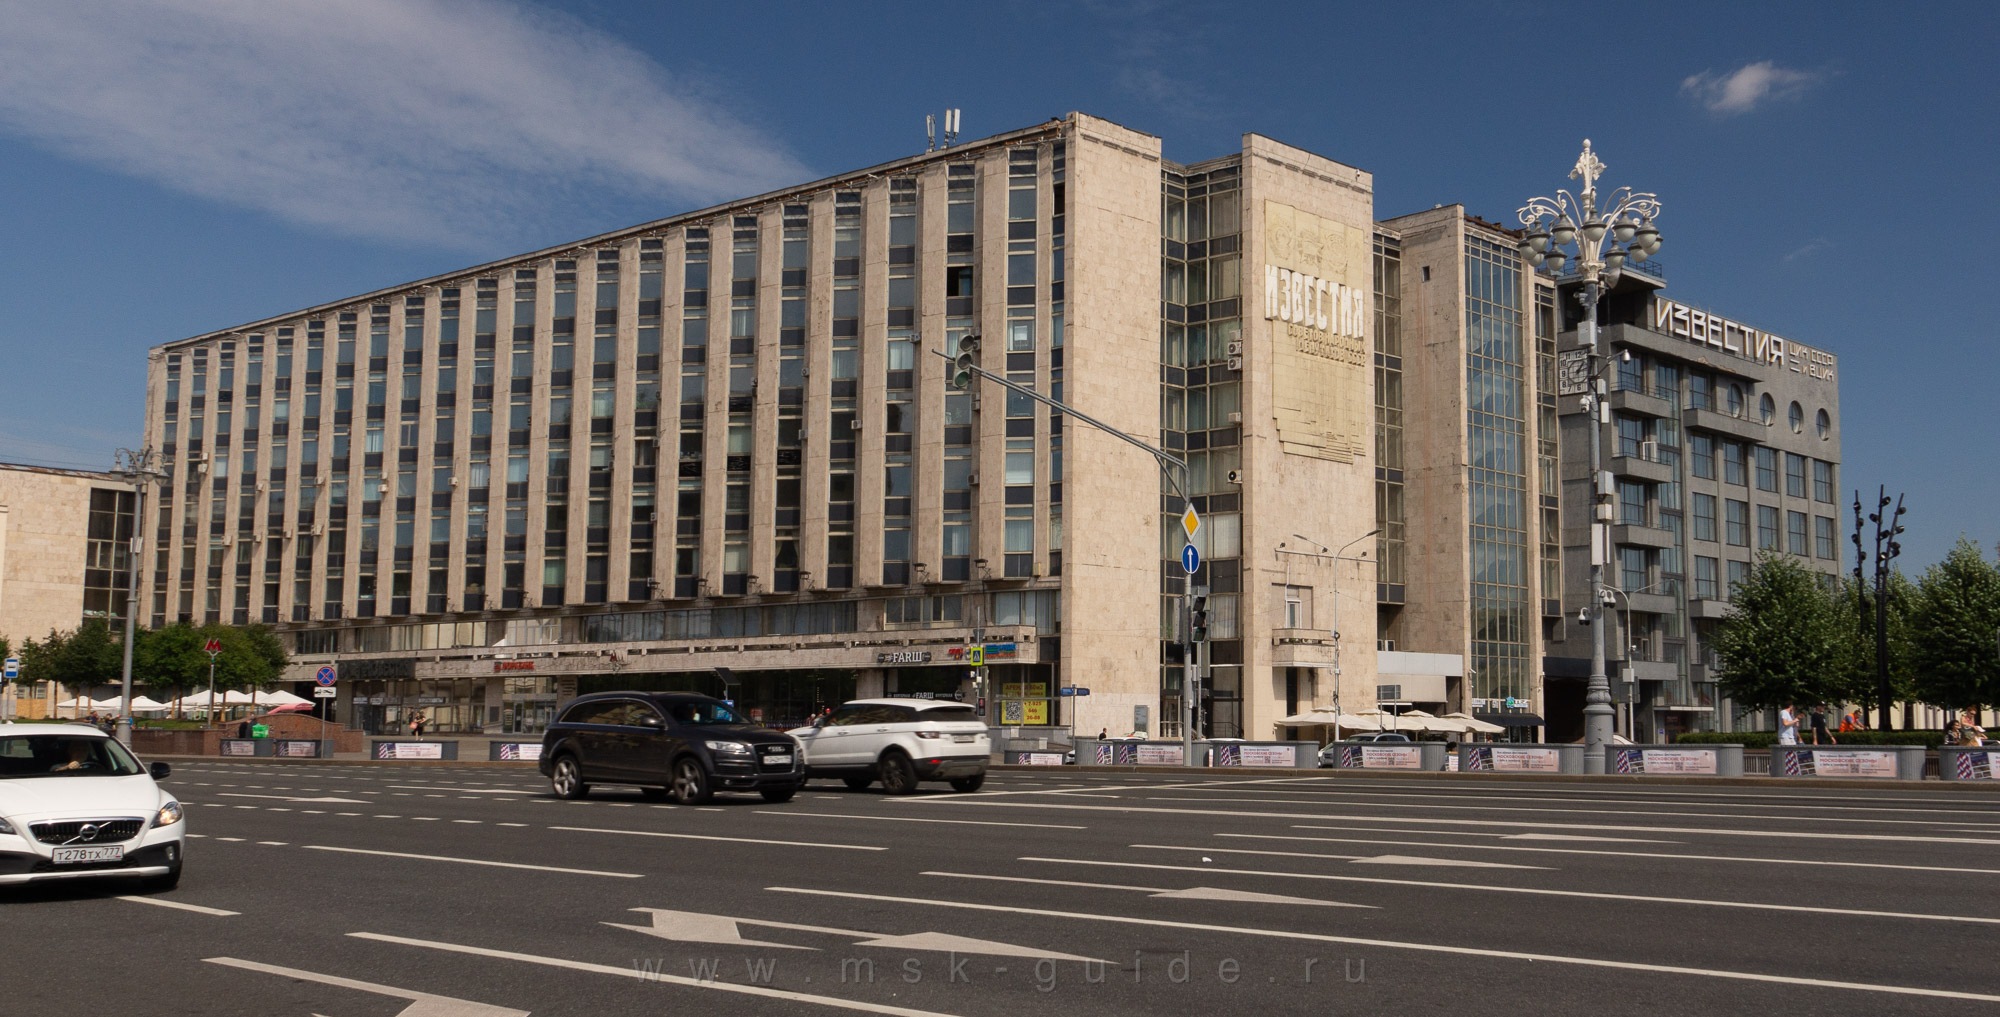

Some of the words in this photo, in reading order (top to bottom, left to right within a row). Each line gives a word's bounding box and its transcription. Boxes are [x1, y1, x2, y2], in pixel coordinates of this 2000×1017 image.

[1265, 264, 1364, 339] ИЗВЕСТИЯ
[1288, 322, 1327, 344] СОВЕТОВ
[1655, 297, 1785, 366] ИЗВЕСТИЯ
[1347, 352, 1366, 368] СССР
[1575, 351, 1582, 359] 12
[1788, 342, 1808, 360] ЦИК
[1810, 349, 1834, 366] СССР
[1808, 364, 1835, 382] ВЦИК
